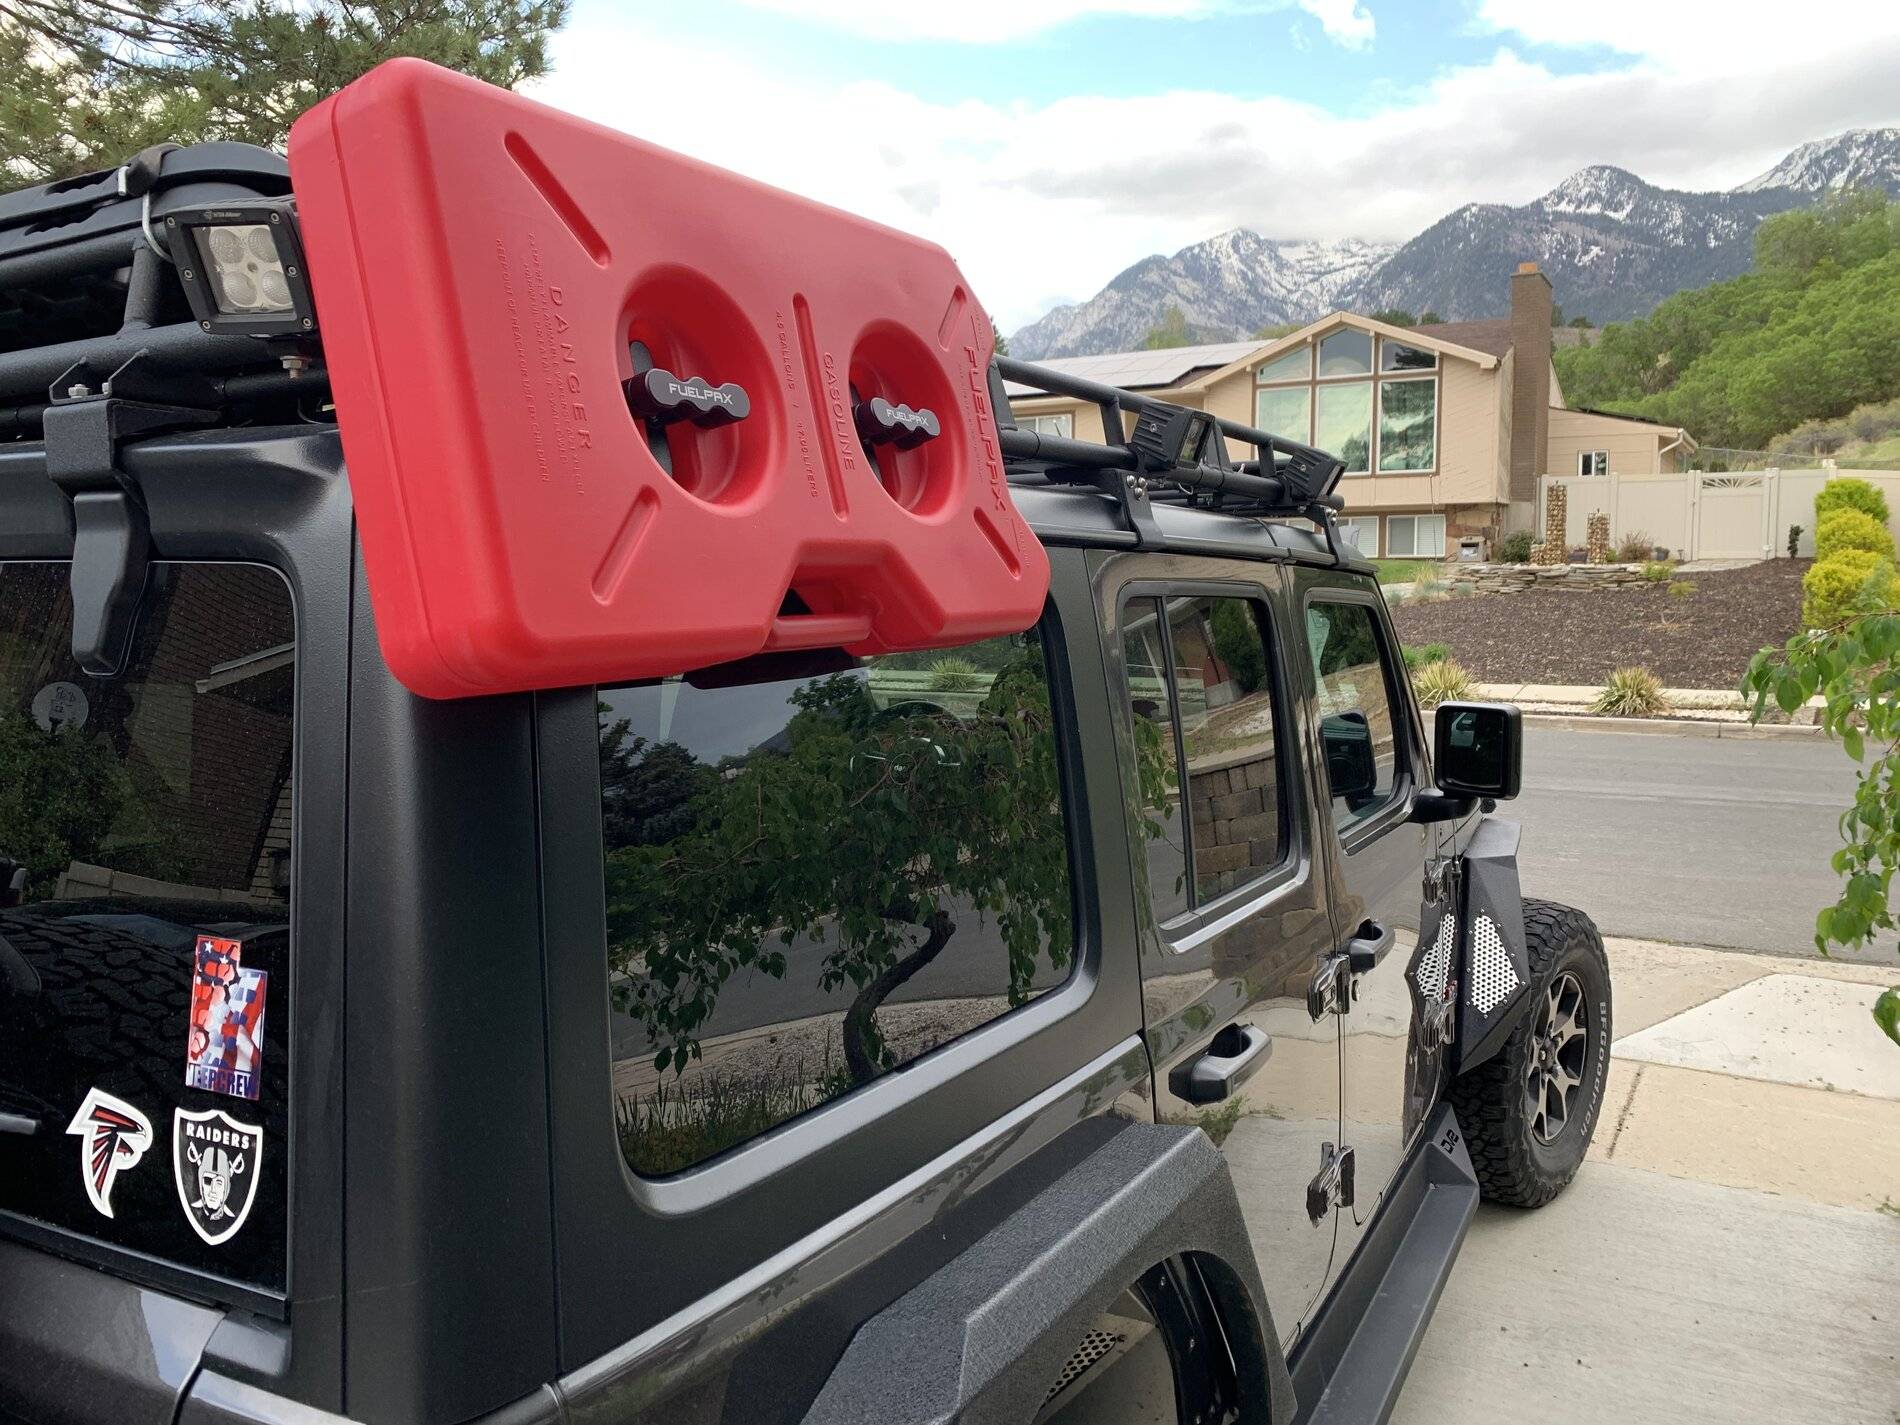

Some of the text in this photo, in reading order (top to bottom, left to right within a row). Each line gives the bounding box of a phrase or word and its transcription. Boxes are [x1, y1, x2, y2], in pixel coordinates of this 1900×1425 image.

[549, 285, 592, 450] DANGER
[668, 382, 733, 405] FUELPAX
[823, 351, 855, 472] GASOLINE
[886, 407, 929, 426] FUELPAX
[963, 345, 1007, 512] FUELPAX
[186, 1121, 251, 1151] RAIDERS
